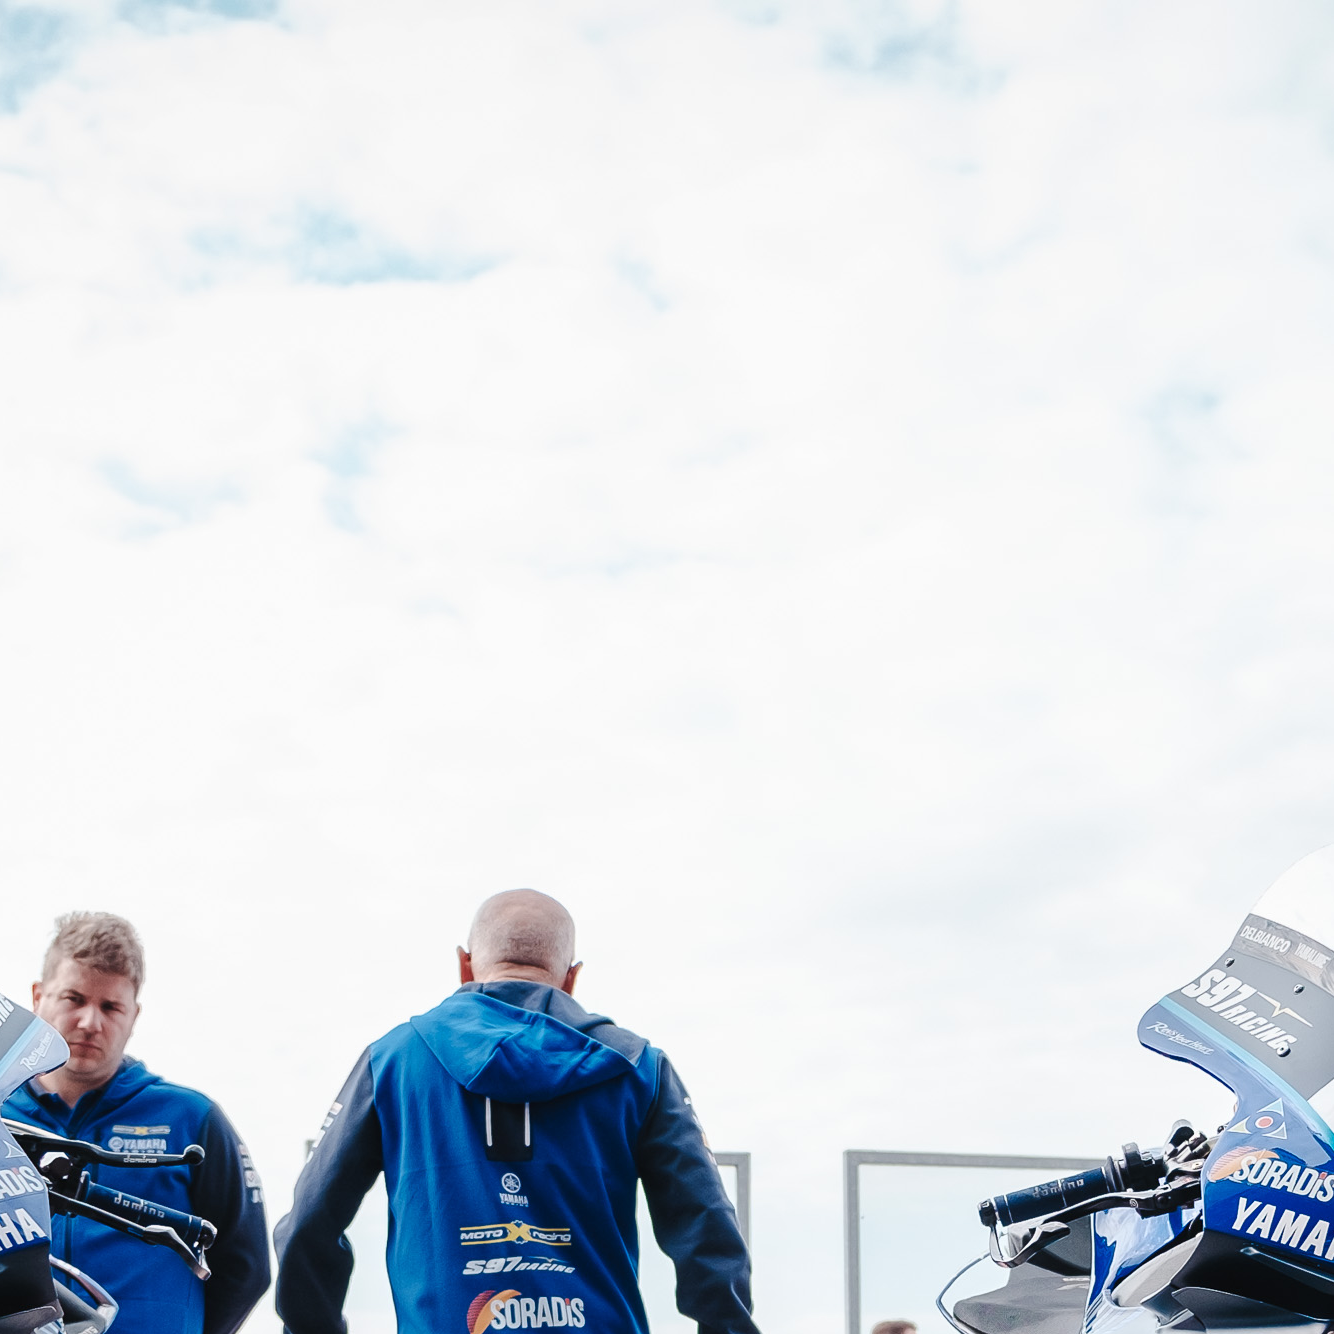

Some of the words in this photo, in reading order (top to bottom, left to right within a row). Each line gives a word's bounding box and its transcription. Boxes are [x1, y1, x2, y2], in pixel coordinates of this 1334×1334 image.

[1240, 925, 1292, 953] DELBIANCO
[123, 1138, 167, 1151] YAMAHA
[113, 1192, 166, 1219] domino
[460, 1229, 503, 1240] MOTO
[532, 1231, 572, 1242] racing
